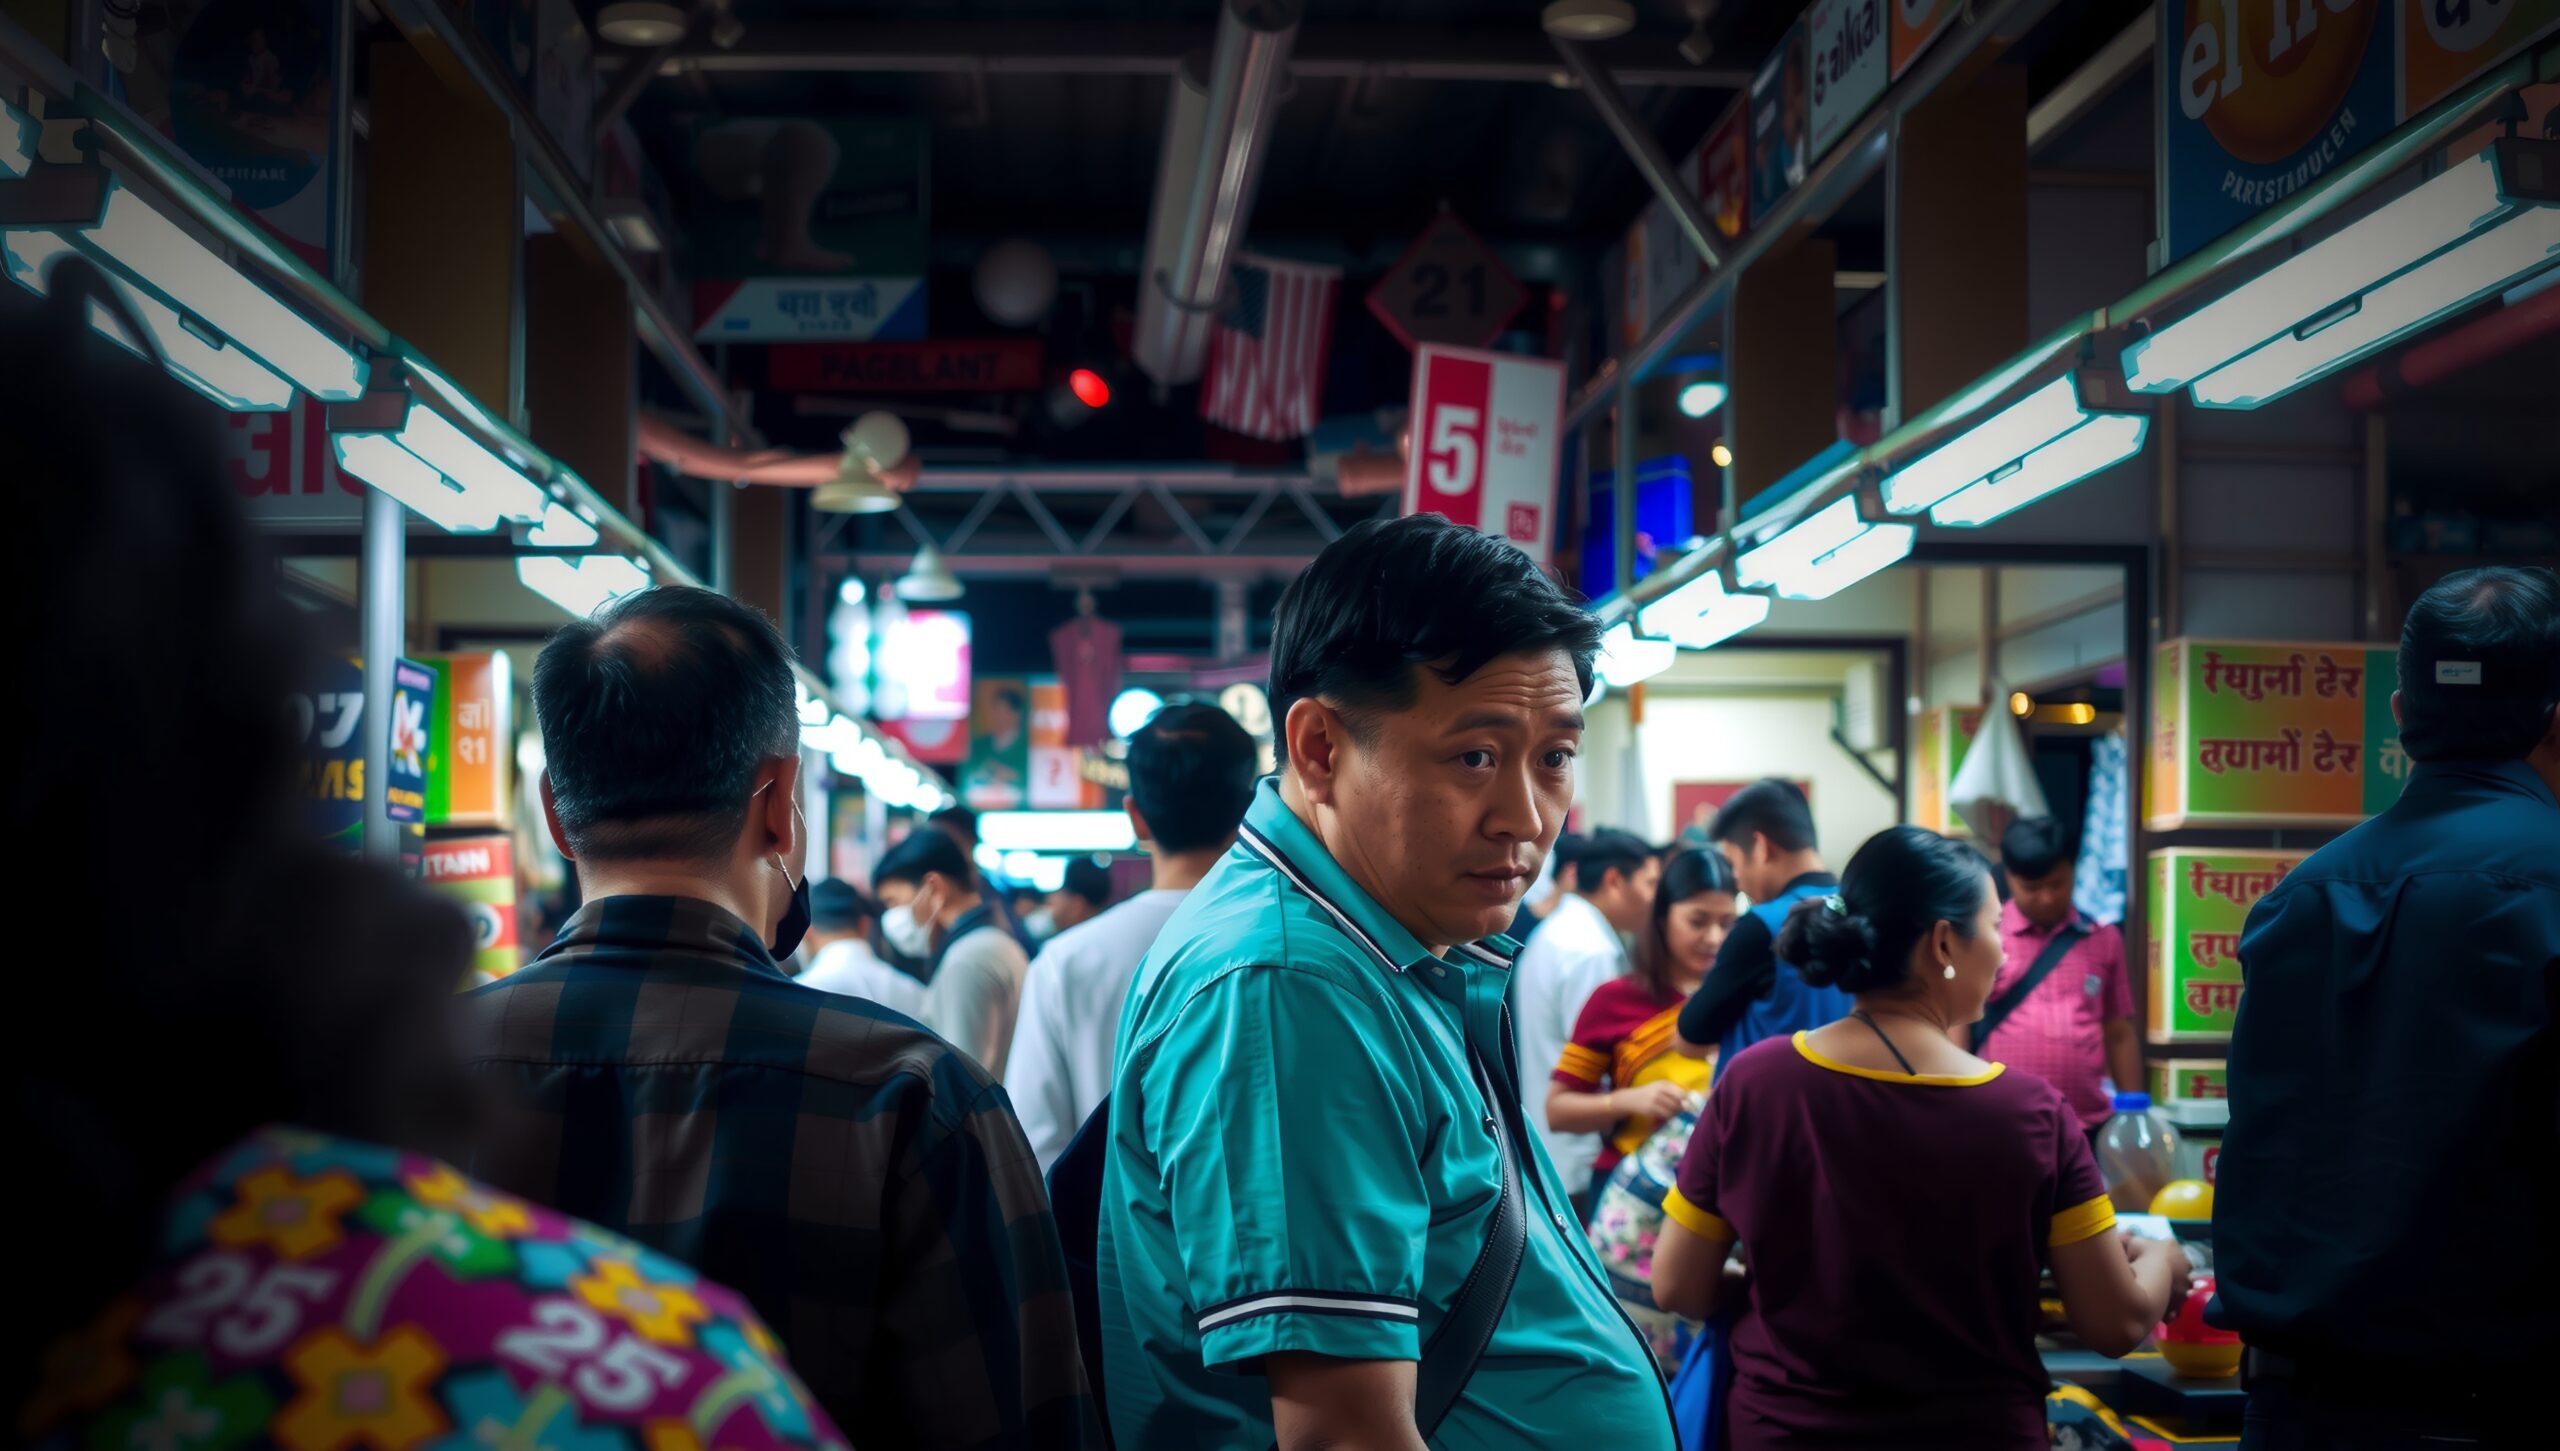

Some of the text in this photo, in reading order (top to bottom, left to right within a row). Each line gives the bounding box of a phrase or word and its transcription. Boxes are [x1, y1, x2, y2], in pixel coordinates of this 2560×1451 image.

[1410, 263, 1486, 318] 21
[1426, 404, 1482, 498] 5
[145, 1252, 338, 1357] 25
[492, 1297, 692, 1411] 25
